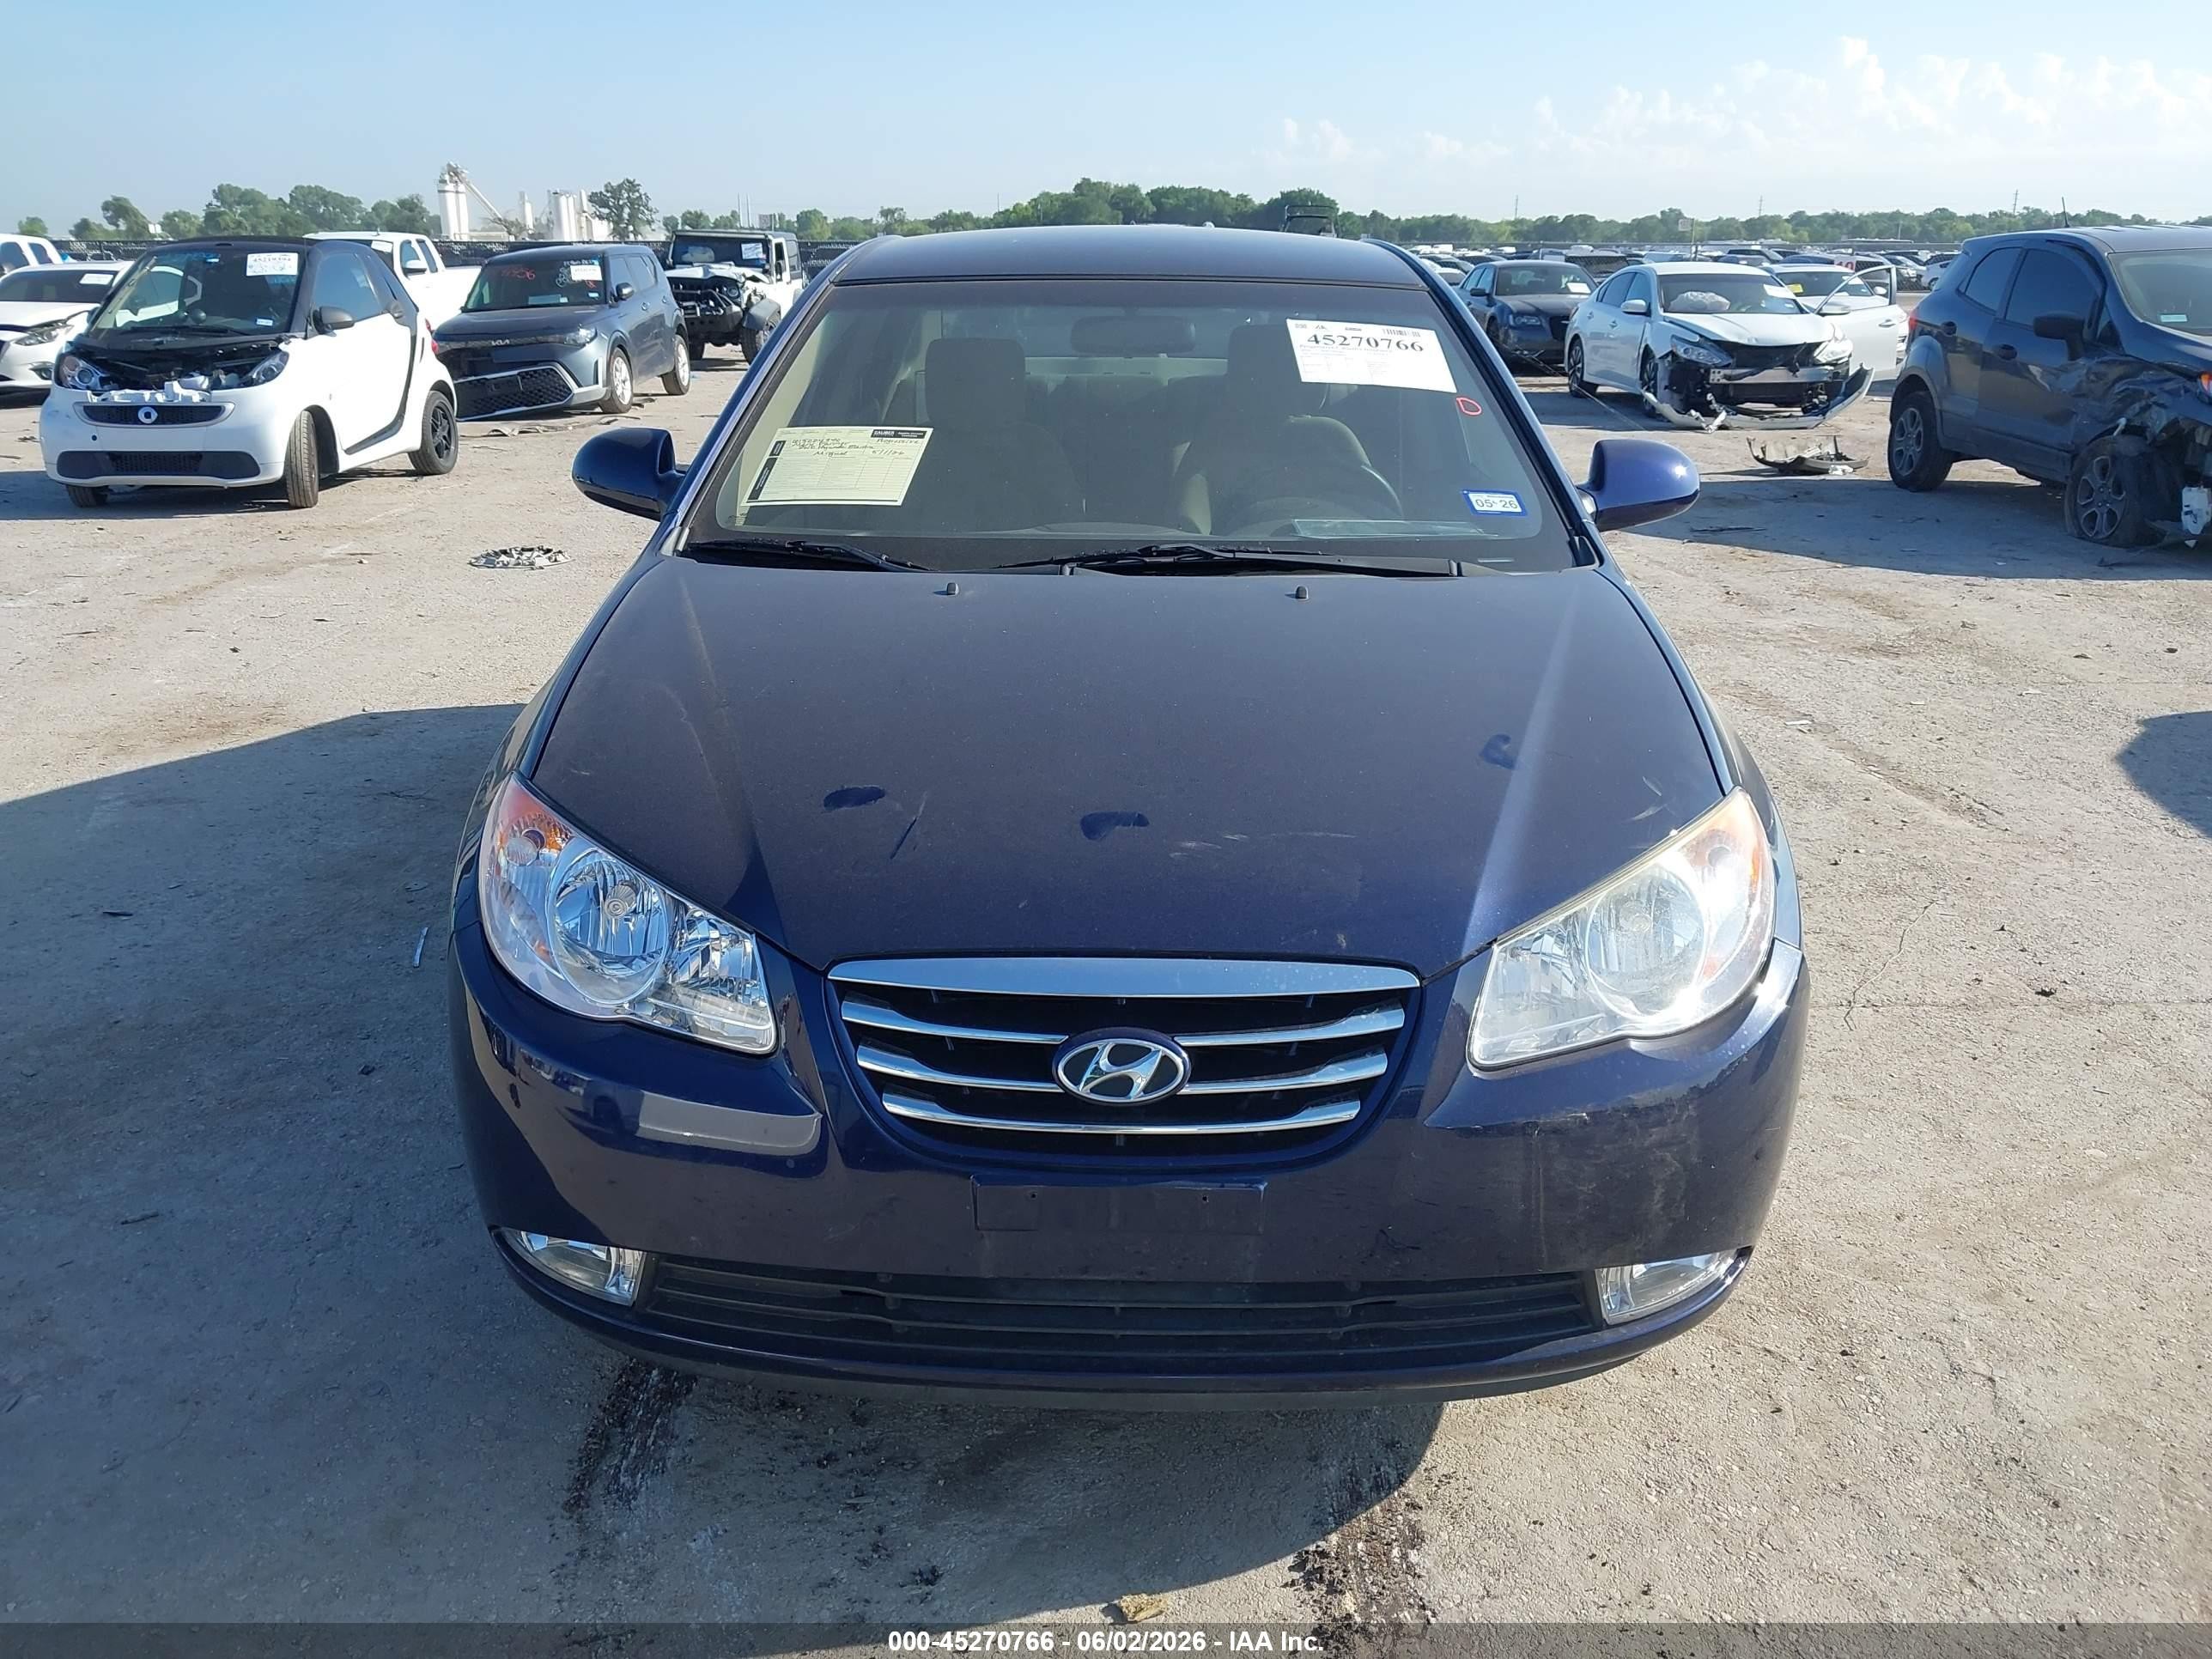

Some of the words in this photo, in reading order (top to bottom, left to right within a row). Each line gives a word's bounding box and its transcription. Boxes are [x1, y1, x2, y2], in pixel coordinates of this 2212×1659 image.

[1307, 333, 1425, 352] 45270766
[1475, 498, 1493, 508] 05
[1498, 499, 1518, 509] 26
